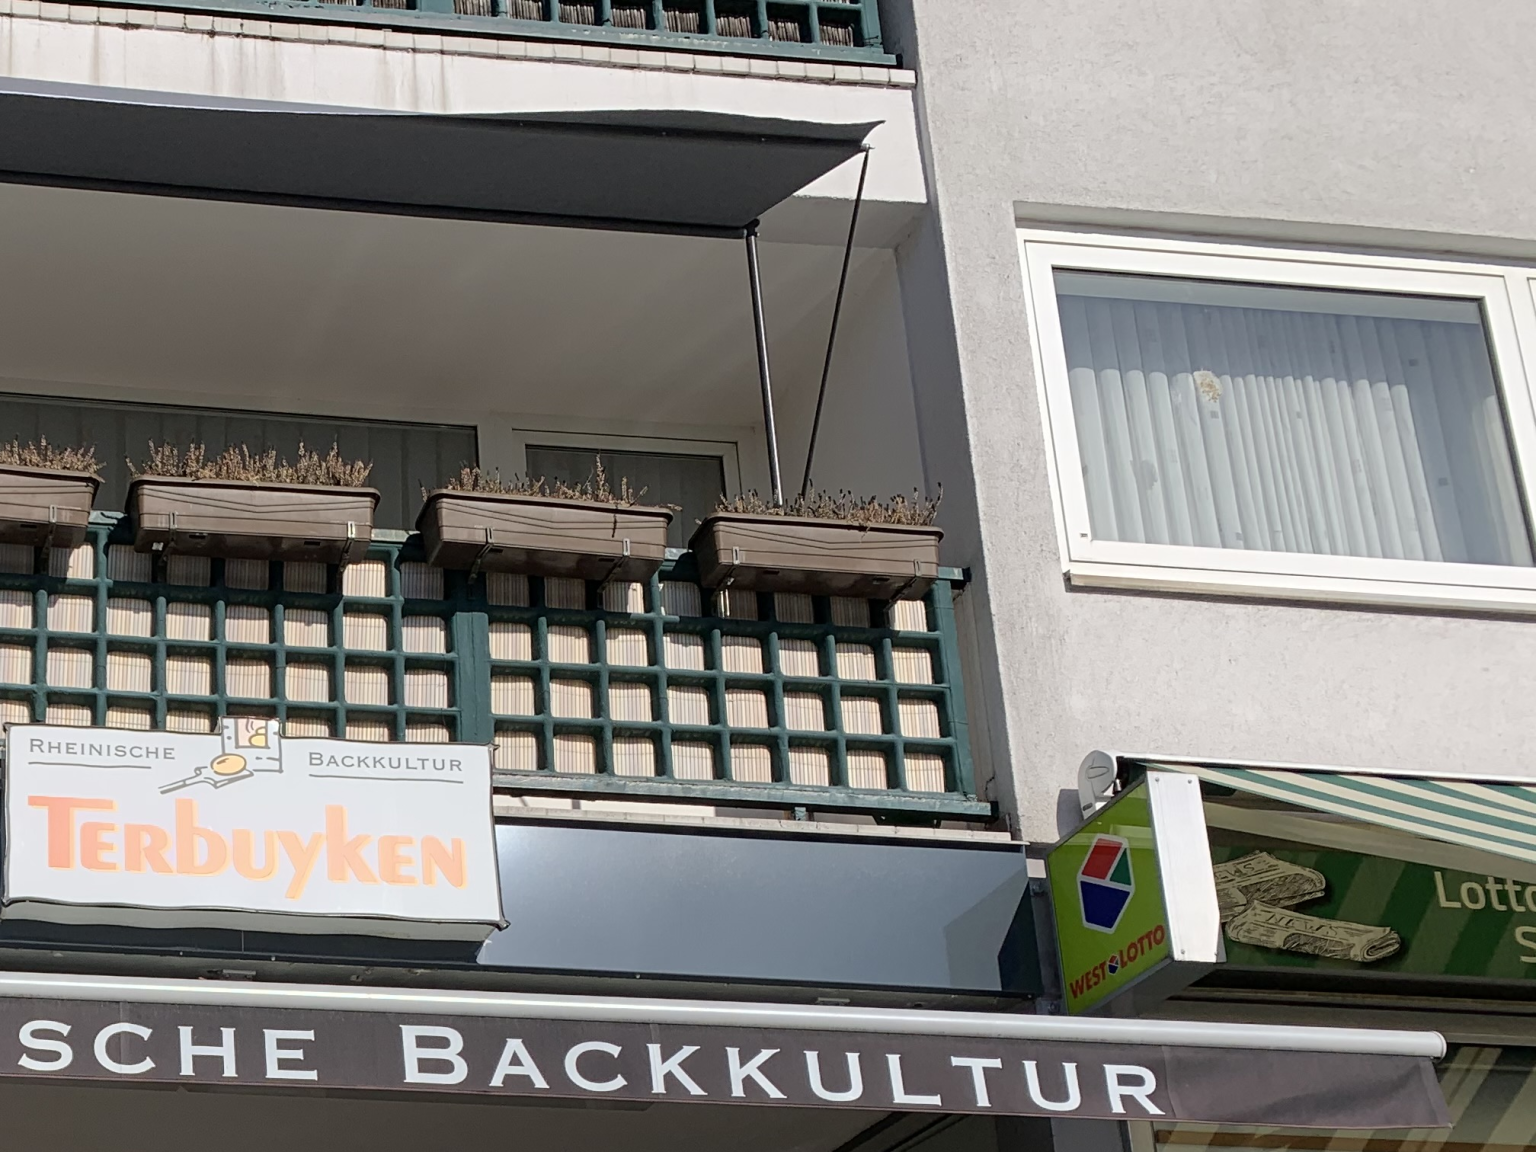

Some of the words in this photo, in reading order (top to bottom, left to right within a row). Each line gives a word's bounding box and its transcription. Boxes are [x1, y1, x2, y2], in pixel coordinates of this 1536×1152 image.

[28, 737, 176, 761] RHEINISCHE
[308, 751, 463, 773] BACKKULTUR
[400, 1024, 1167, 1118] BACKKULTUR
